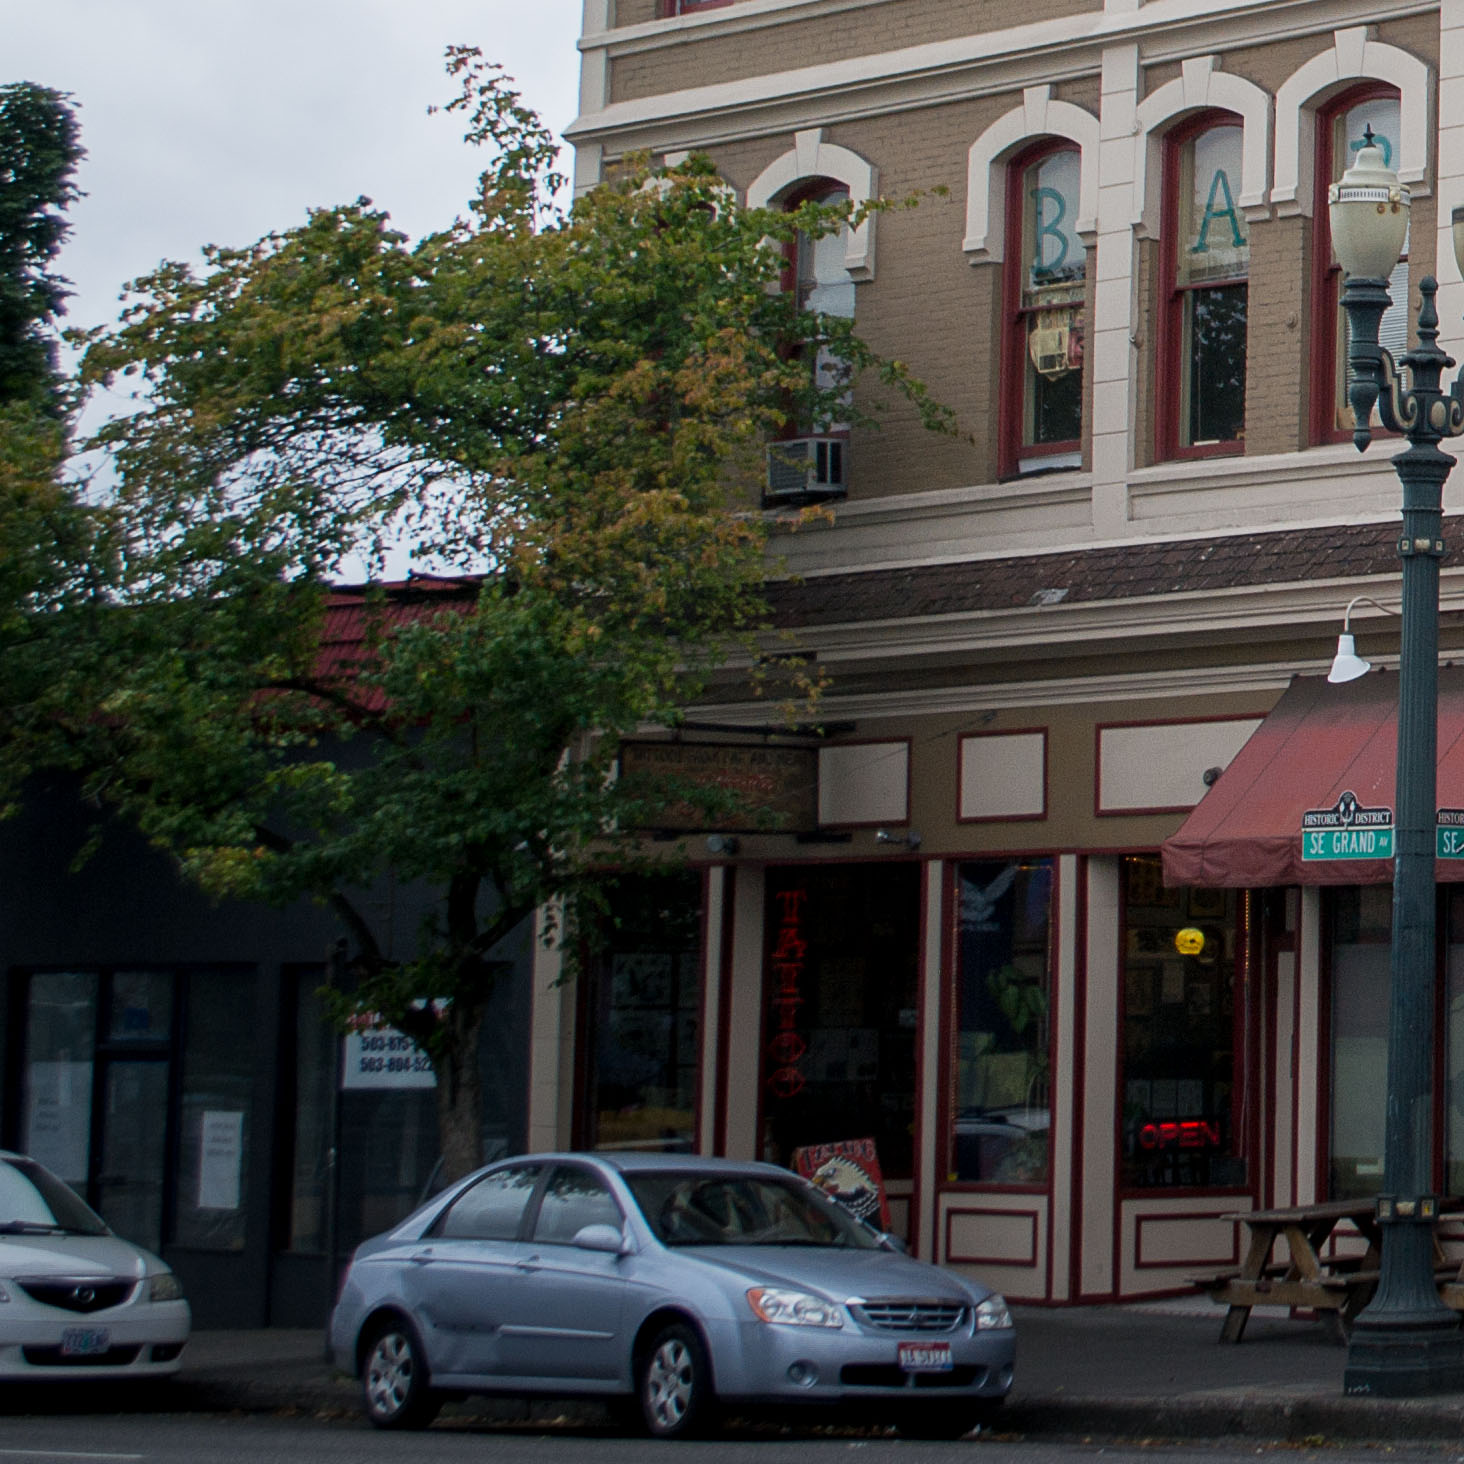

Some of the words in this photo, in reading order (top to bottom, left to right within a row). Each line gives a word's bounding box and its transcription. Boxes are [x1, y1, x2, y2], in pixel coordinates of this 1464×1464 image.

[1305, 814, 1340, 826] HISTORIC
[1354, 812, 1391, 825] DISTRICT
[1309, 831, 1325, 855] SE
[1333, 832, 1375, 854] GRAND
[1378, 837, 1389, 847] AV
[1443, 831, 1458, 854] SE
[768, 889, 808, 1100] TATTOO
[1139, 1121, 1222, 1150] OPEN
